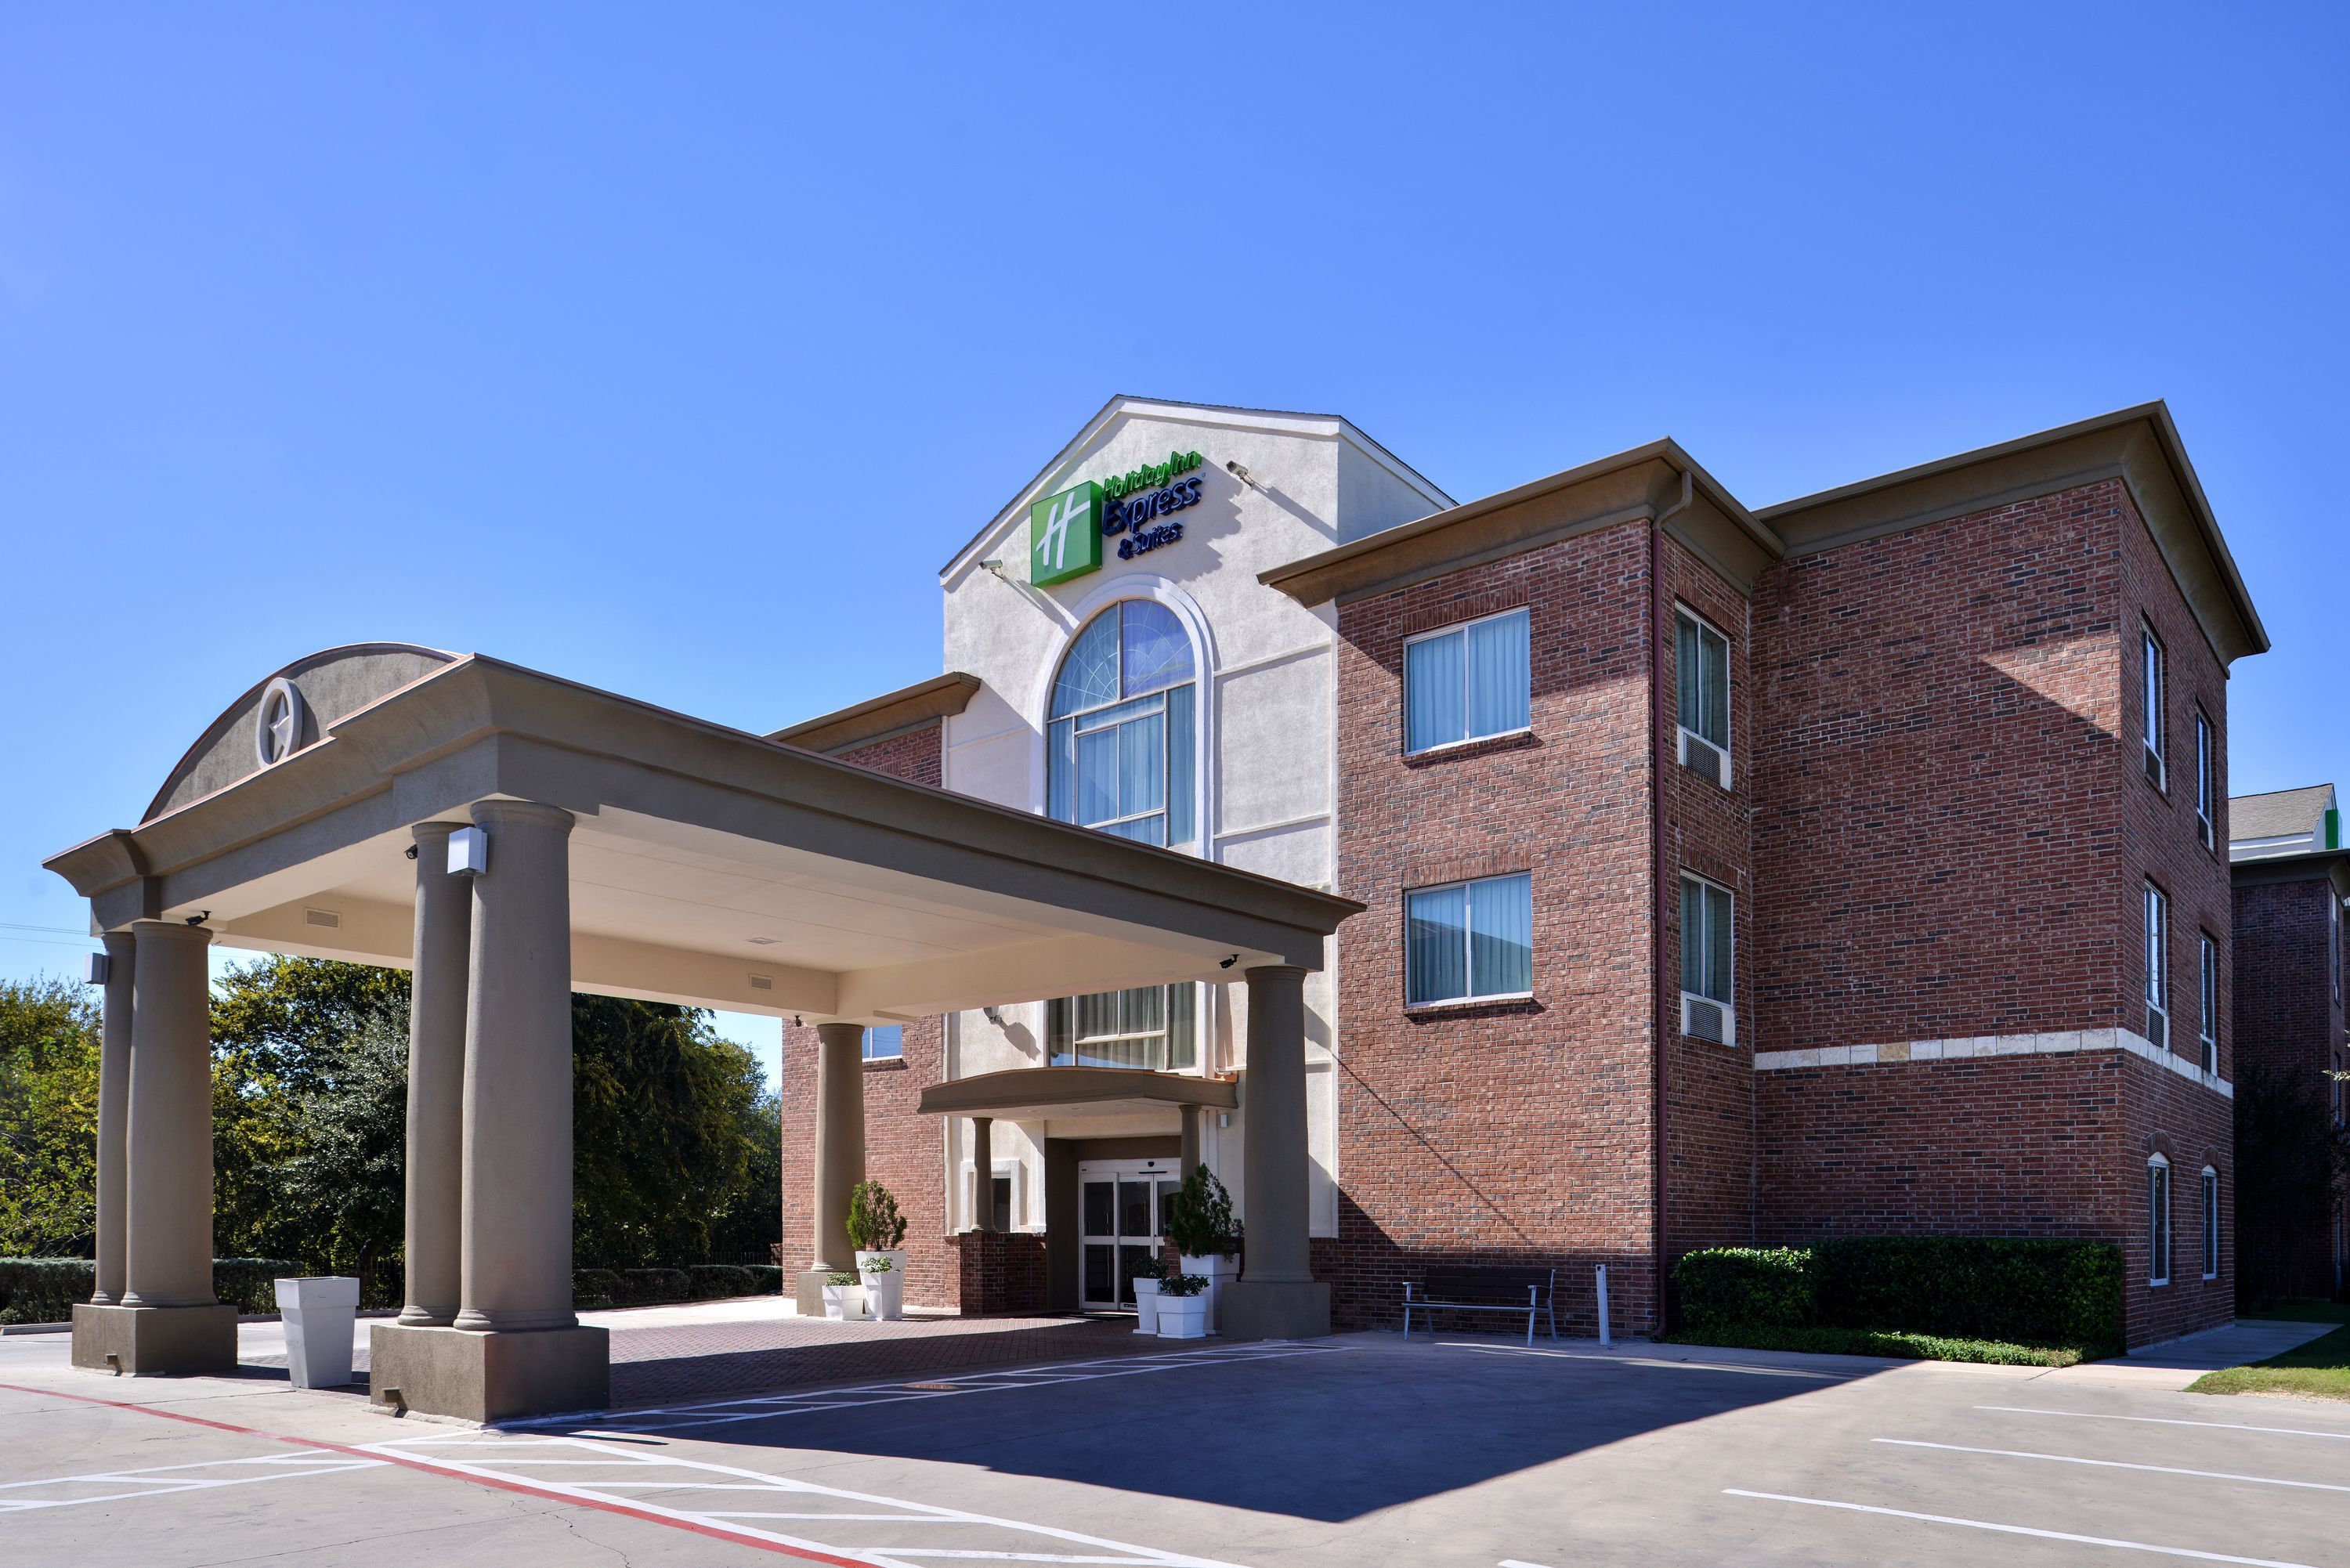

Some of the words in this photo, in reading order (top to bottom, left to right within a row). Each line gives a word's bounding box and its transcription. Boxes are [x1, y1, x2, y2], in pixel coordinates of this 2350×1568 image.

[1103, 462, 1170, 502] Holiday
[1170, 450, 1202, 476] Inn
[1102, 477, 1202, 537] Express
[1118, 538, 1134, 560] &
[1133, 522, 1184, 555] Suites
